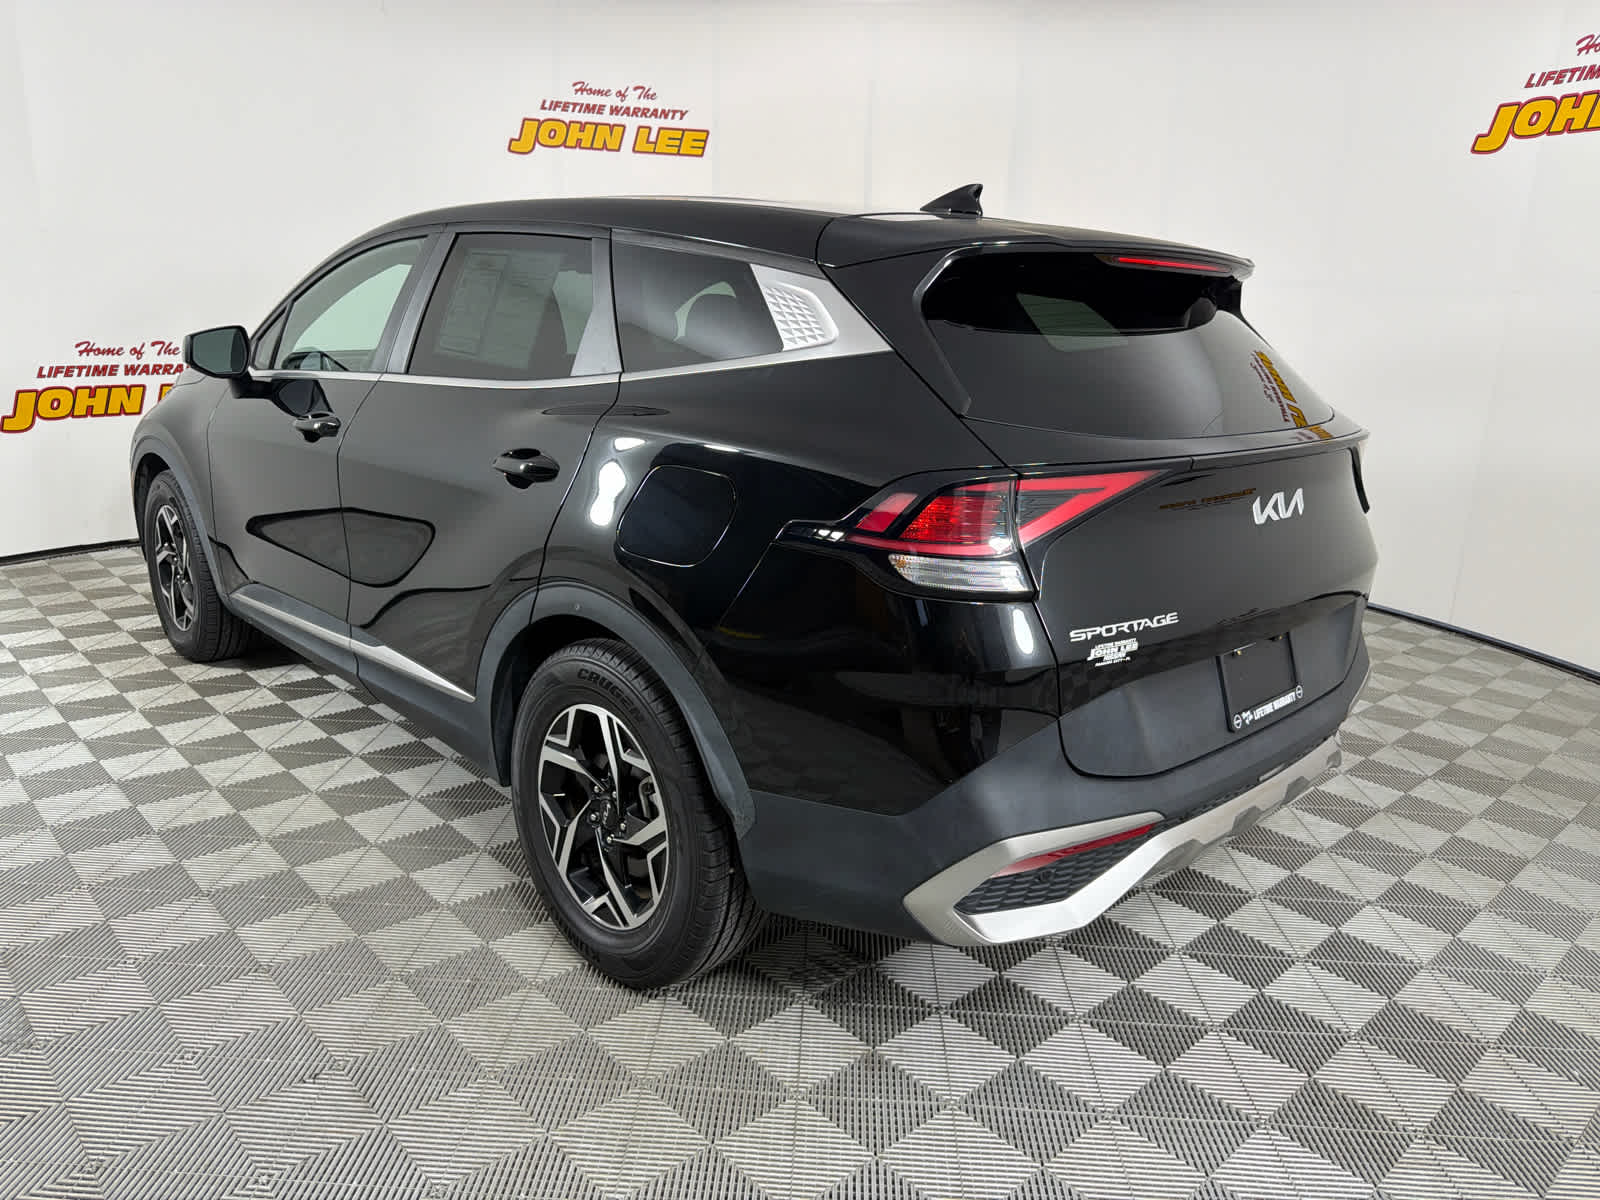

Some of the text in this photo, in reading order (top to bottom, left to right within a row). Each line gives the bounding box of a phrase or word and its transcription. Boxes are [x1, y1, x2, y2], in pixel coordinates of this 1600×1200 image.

[572, 81, 658, 102] Home of The
[540, 99, 688, 120] LIFETIME WARRANTY
[508, 118, 709, 157] JOHN LEE
[75, 341, 181, 359] Home of The
[37, 363, 190, 378] LIFETIME WARRA
[0, 384, 146, 433] JOHN
[1069, 612, 1180, 642] SPORTAGE
